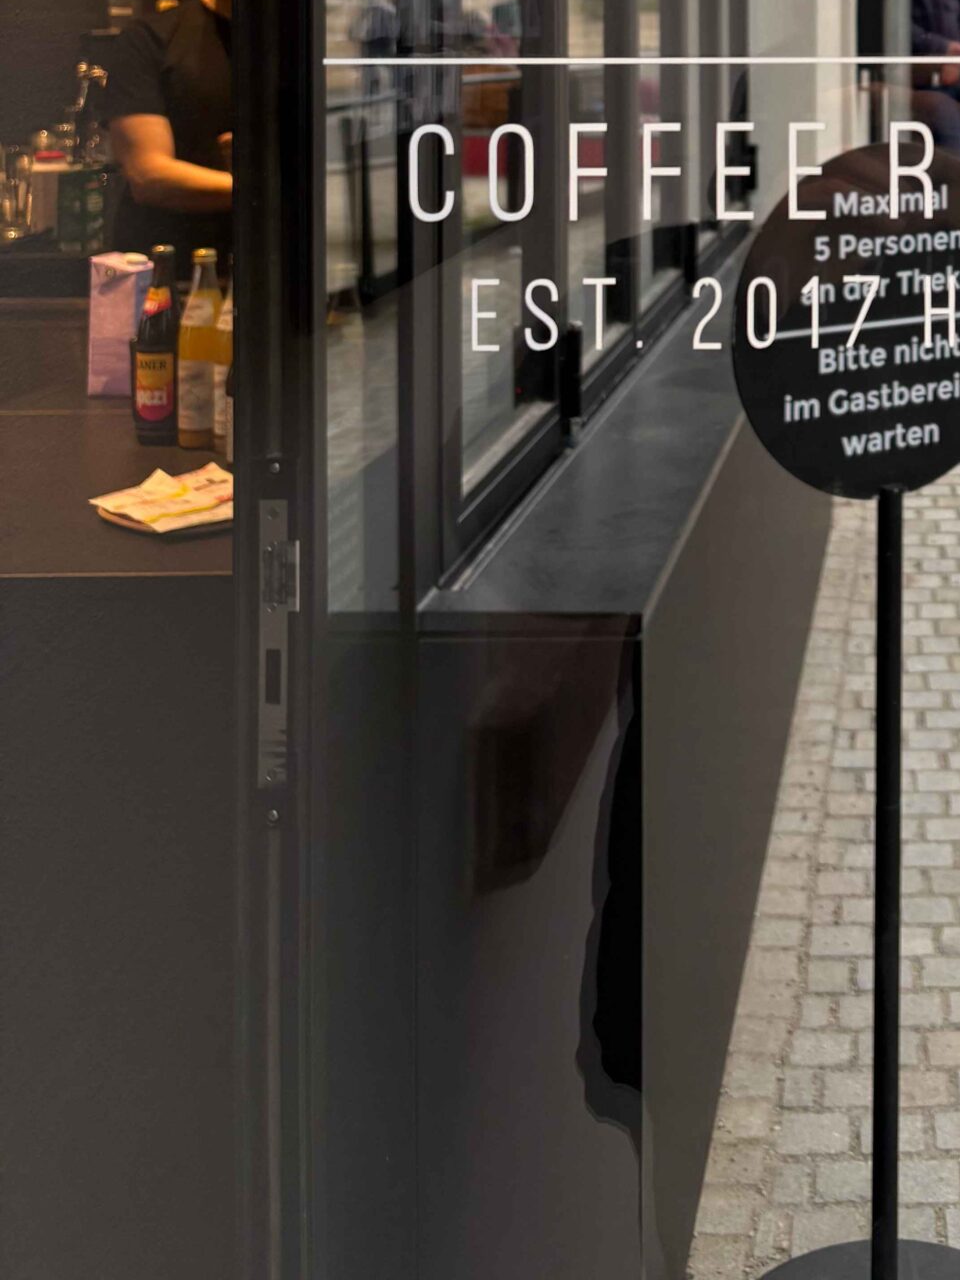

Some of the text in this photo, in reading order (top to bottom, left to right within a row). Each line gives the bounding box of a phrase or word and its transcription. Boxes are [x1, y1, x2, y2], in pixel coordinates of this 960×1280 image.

[408, 122, 827, 222] COFFEE
[833, 183, 948, 218] Maxmal
[814, 235, 831, 262] 5
[470, 276, 644, 352] EST.
[693, 274, 881, 350] 2017
[818, 343, 887, 374] Bitte
[783, 394, 820, 423] im
[841, 422, 940, 457] warten
